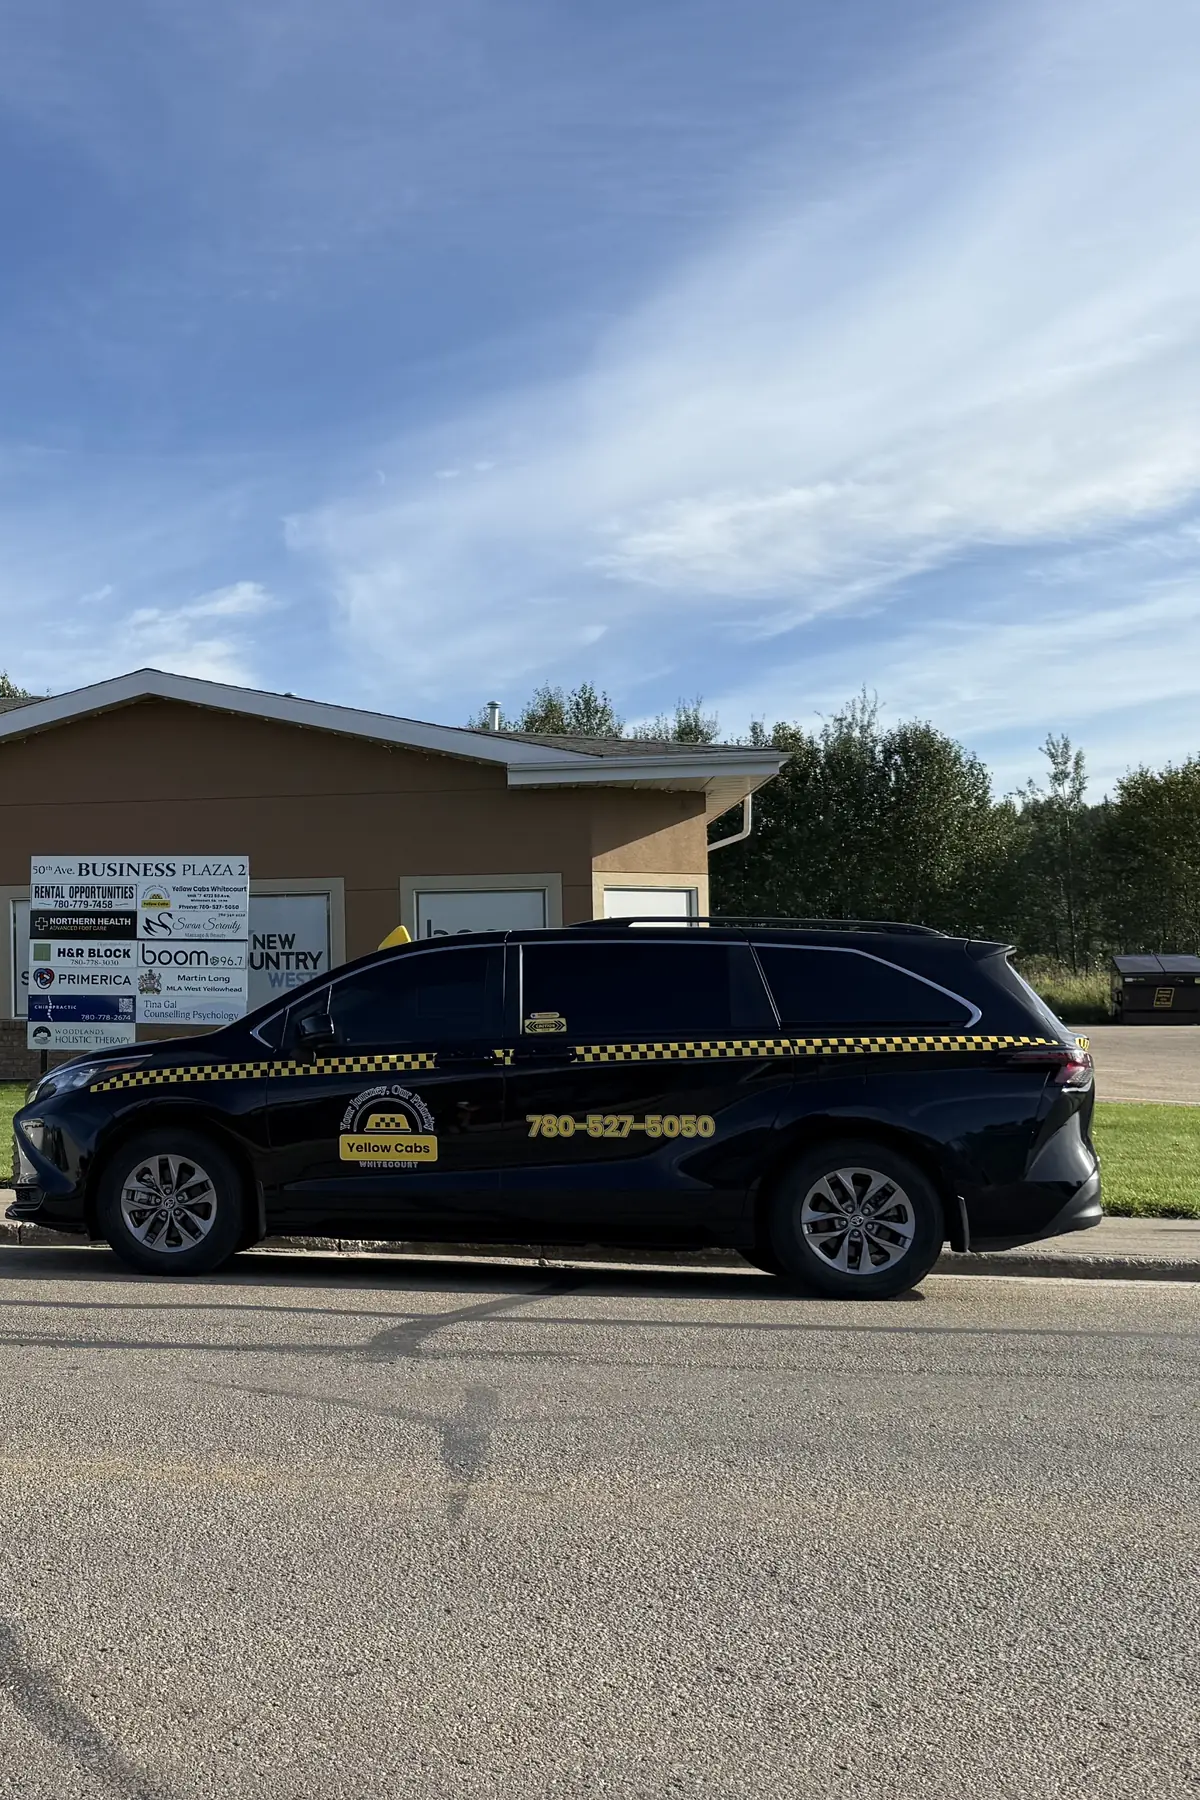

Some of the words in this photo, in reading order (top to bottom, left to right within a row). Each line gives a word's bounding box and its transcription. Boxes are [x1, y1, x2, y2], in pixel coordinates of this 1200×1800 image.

[32, 865, 53, 875] 50th
[54, 865, 75, 875] Ave.
[78, 862, 176, 877] BUSINESS
[182, 864, 234, 876] PLAZA
[238, 864, 247, 876] 2
[34, 886, 65, 899] RENTAL
[69, 886, 134, 900] OPPORTUNITIES
[54, 901, 113, 909] 780-779-7458
[49, 917, 94, 926] NORTHERN
[97, 917, 131, 926] HEALTH
[172, 917, 201, 930] Swan
[202, 917, 242, 934] Serenity
[252, 933, 296, 950] NEW
[57, 947, 84, 958] H&R
[88, 948, 131, 958] BLOCK
[141, 943, 208, 965] boom
[220, 956, 243, 966] 96.7
[249, 951, 323, 970] UNTRY
[58, 974, 132, 985] PRIMERICA
[177, 974, 206, 982] Martin
[208, 975, 230, 984] Long
[144, 1000, 162, 1009] Tina
[164, 1000, 177, 1009] Gal
[144, 1009, 191, 1020] Counselling
[193, 1010, 239, 1021] Psychology
[55, 1036, 92, 1044] HOLISTIC
[94, 1036, 132, 1044] THERAPY
[339, 1106, 356, 1131] Your
[391, 1084, 412, 1100] Our
[526, 1114, 716, 1138] 780-527-5050
[347, 1142, 391, 1153] Yellow
[394, 1142, 430, 1153] Cabs
